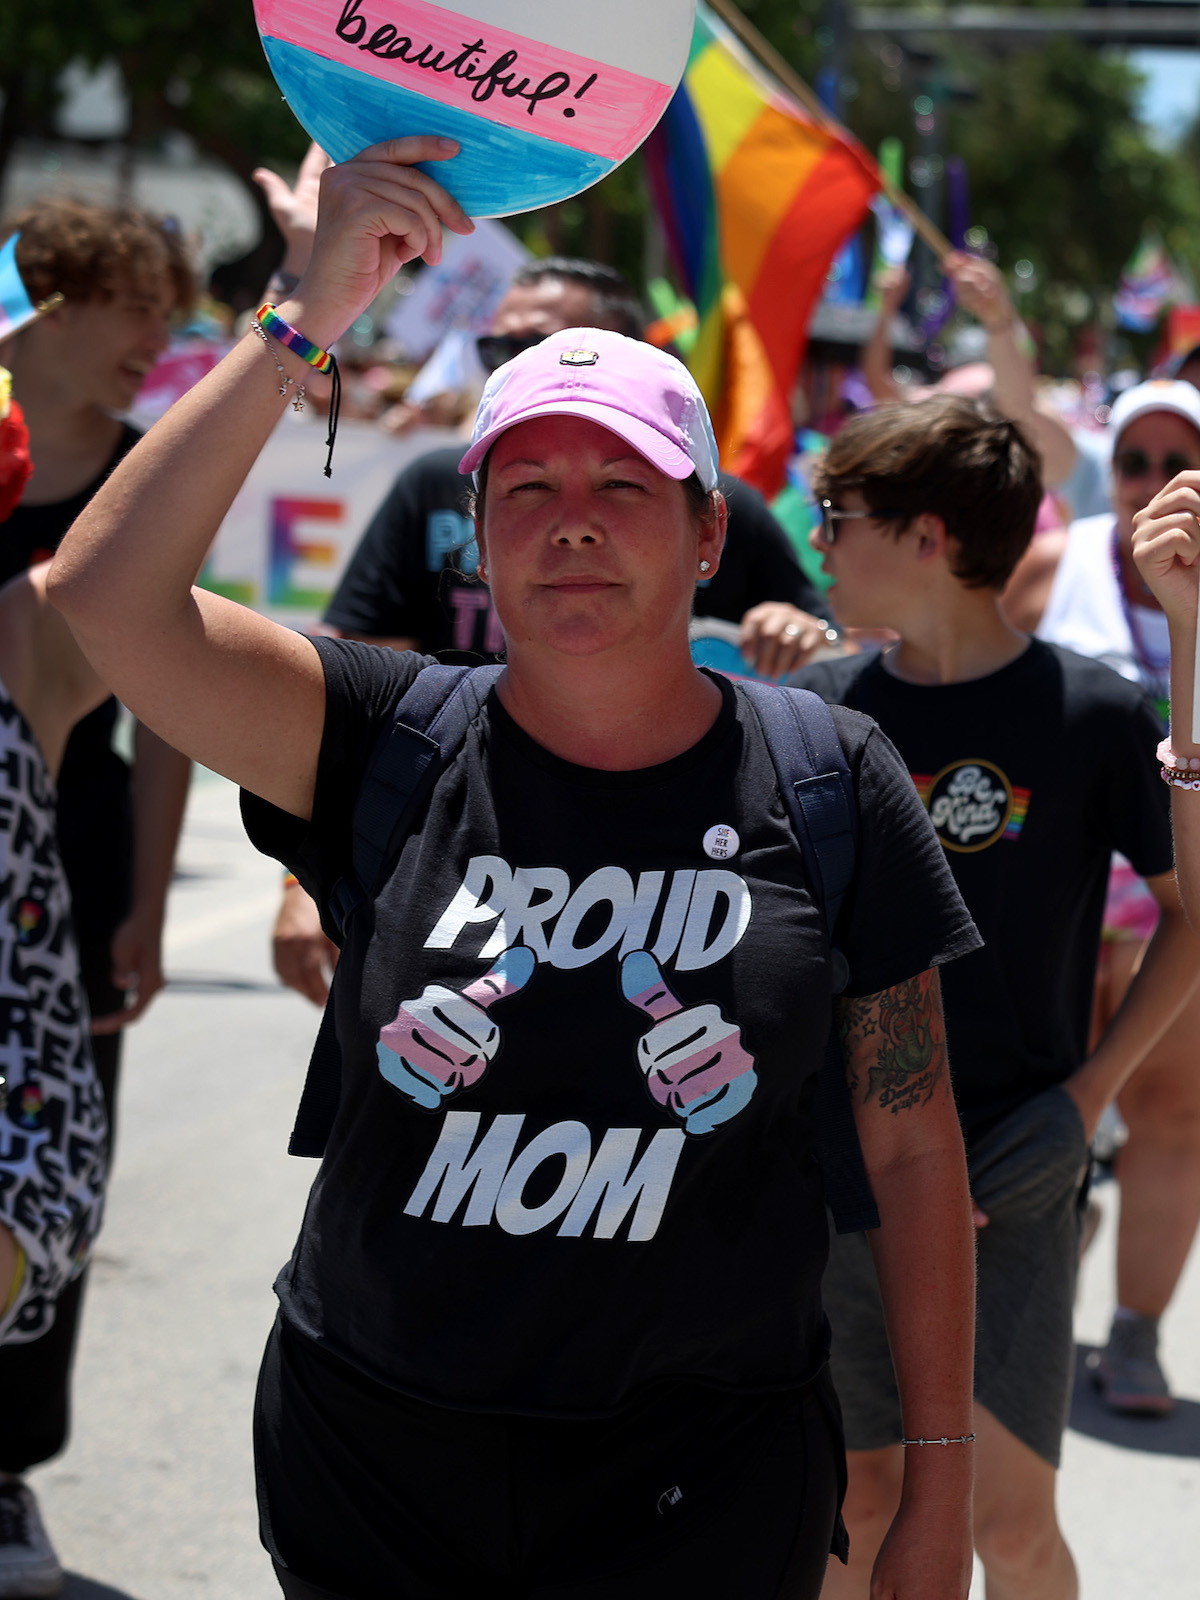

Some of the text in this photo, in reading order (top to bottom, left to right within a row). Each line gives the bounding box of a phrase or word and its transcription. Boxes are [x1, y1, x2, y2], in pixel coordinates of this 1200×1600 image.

[335, 0, 598, 118] beautiful!
[947, 765, 993, 804] Be
[714, 837, 728, 848] HER
[929, 788, 1007, 843] Kind
[710, 847, 728, 858] HERS
[422, 855, 753, 972] PROUD
[403, 1111, 687, 1242] MOM
